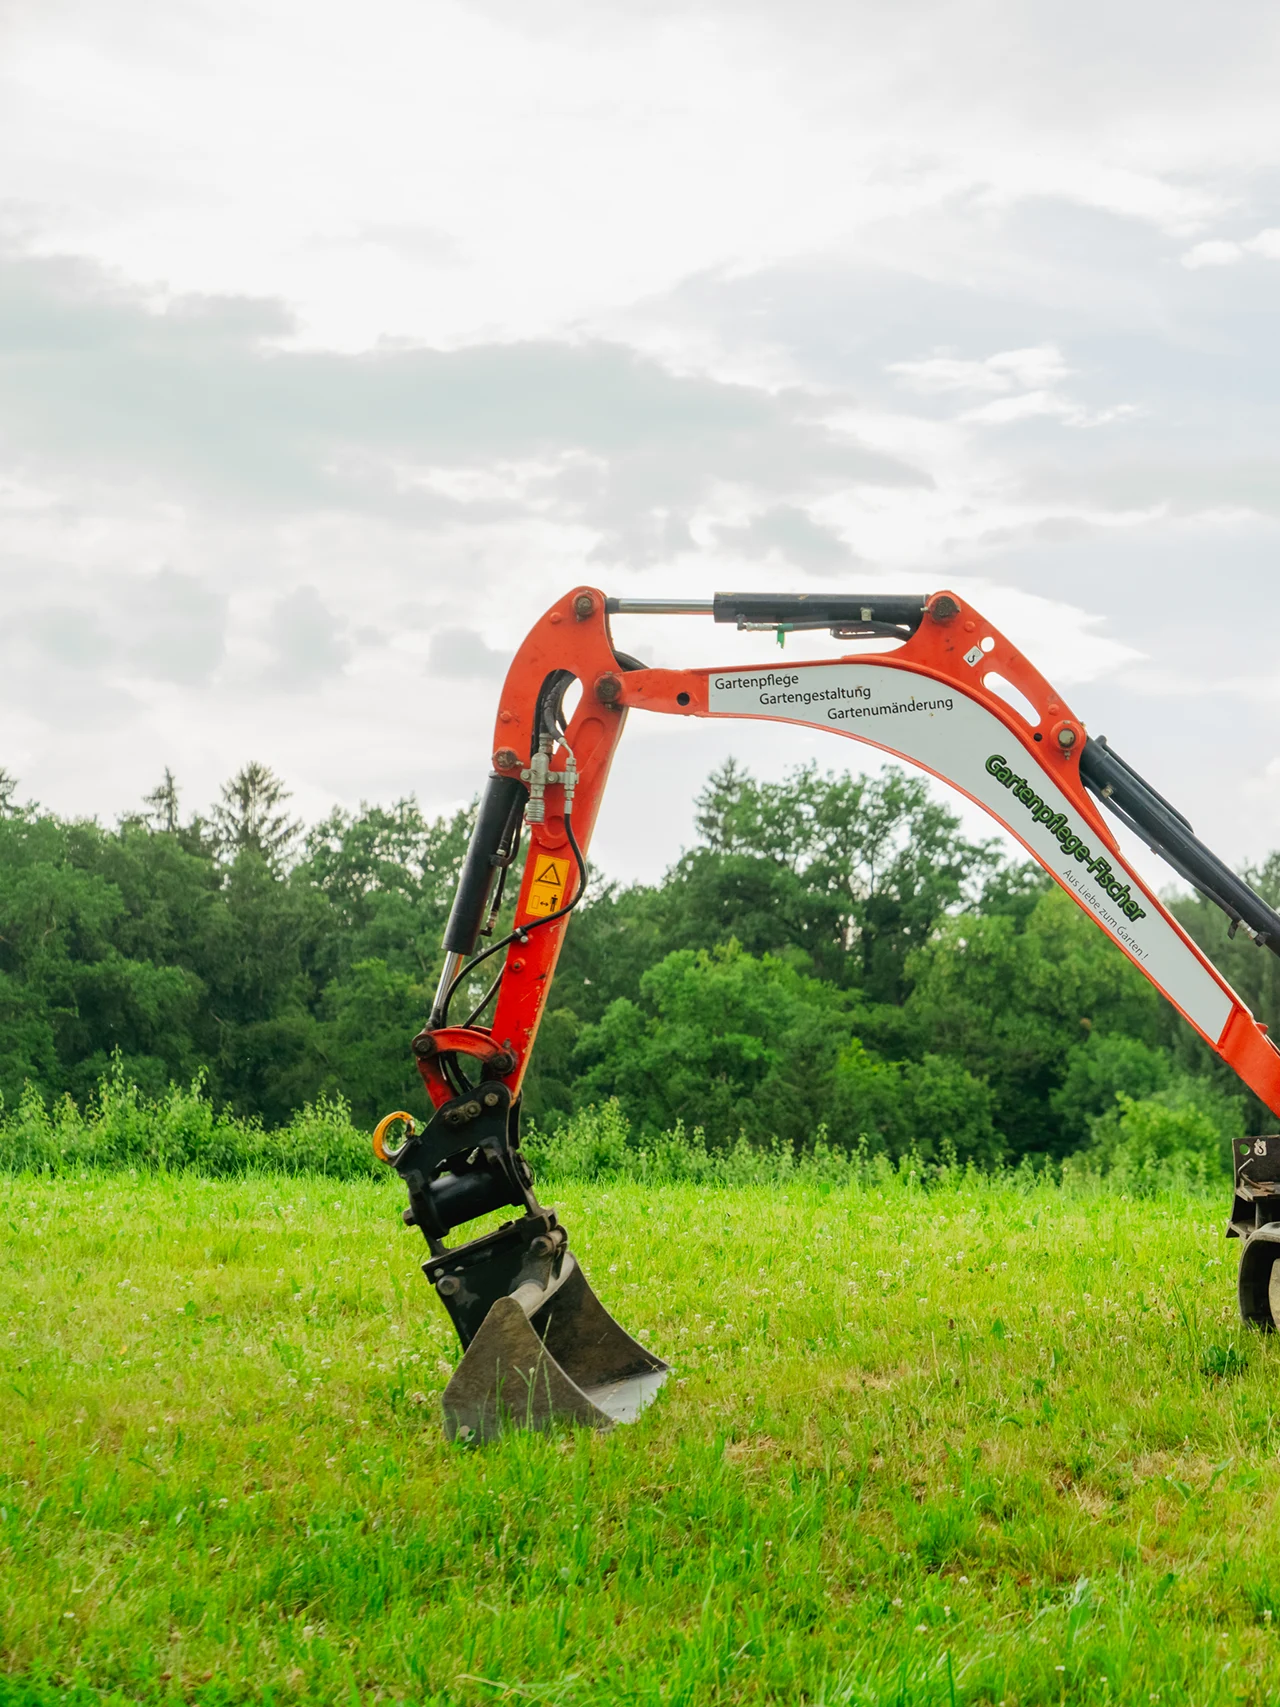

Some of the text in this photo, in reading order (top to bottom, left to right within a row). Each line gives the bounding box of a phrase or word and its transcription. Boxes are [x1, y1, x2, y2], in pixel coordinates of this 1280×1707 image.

[714, 674, 799, 689] Gartenpflege
[759, 686, 871, 705] Gartengestaltung
[827, 697, 953, 720] Gartenumänderung
[984, 754, 1147, 923] Gartenpflege-Fischer
[1062, 869, 1079, 888] Aus
[1078, 884, 1101, 911] Liebe
[1098, 907, 1118, 929] zum
